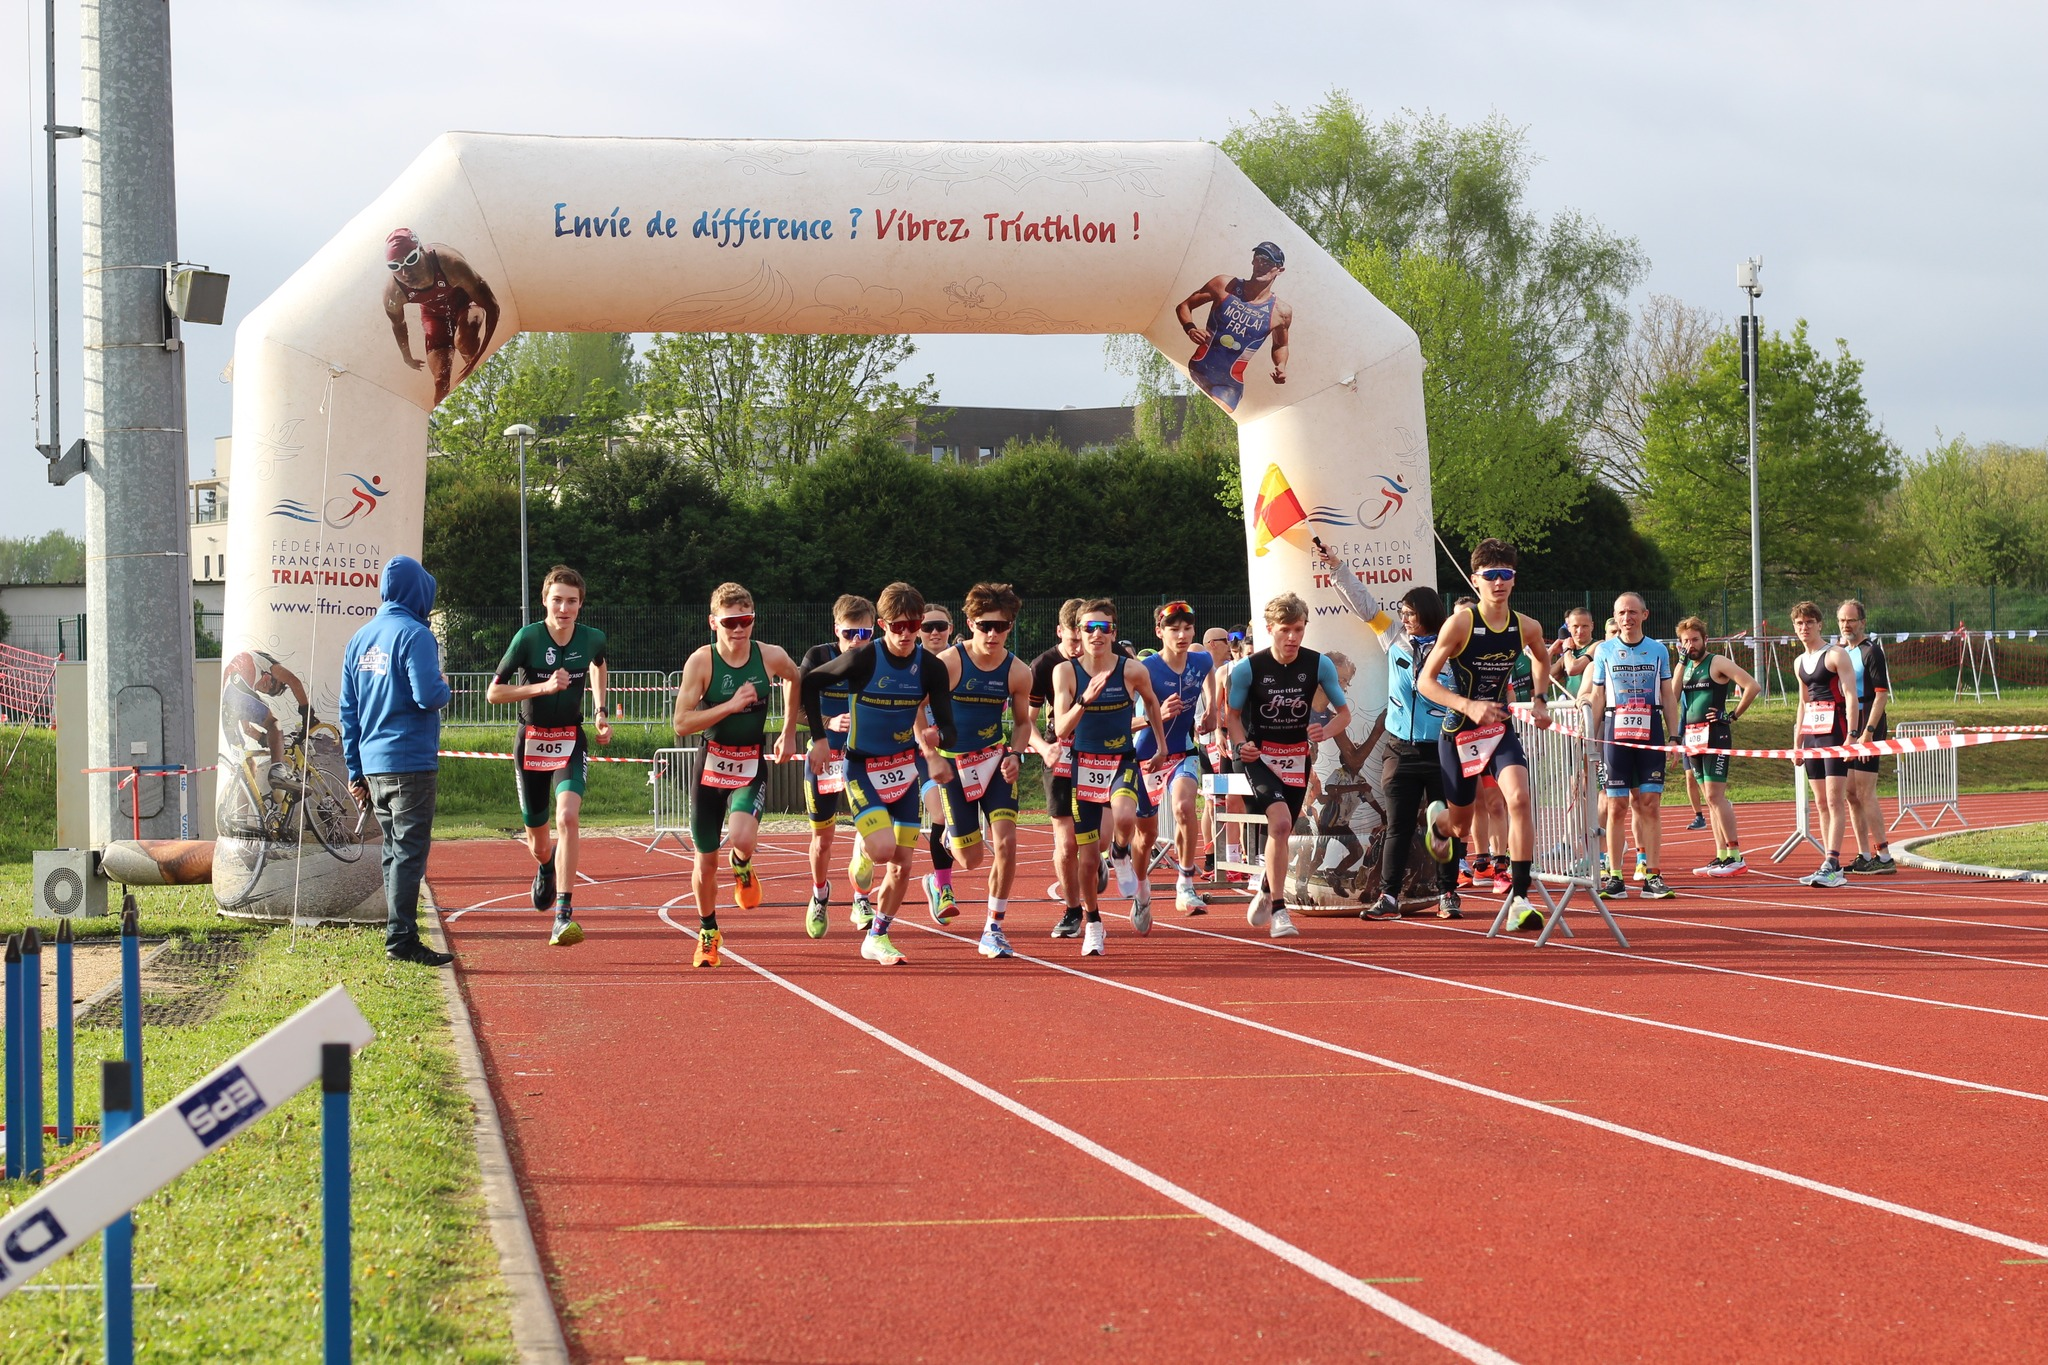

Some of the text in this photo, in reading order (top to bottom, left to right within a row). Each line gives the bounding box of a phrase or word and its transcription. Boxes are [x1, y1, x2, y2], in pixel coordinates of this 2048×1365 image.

[554, 203, 1140, 249] Envie de différence ? Vibrez Triathlon !
[1226, 320, 1246, 338] FRA
[272, 539, 380, 555] FÉDÉRATION
[1311, 540, 1410, 556] FDÉRATION
[272, 555, 379, 570] FRANÇAISE DE
[1312, 554, 1411, 570] FRÇAISE DE
[272, 570, 379, 588] TRIATHLON
[1313, 568, 1412, 588] TRTHLON
[1623, 716, 1642, 726] 378
[1473, 726, 1504, 737] balance
[536, 744, 562, 754] 405
[726, 750, 757, 758] balance
[974, 748, 1003, 762] balance
[1470, 744, 1478, 756] 3
[717, 761, 744, 772] 411
[868, 754, 913, 769] new balance
[1080, 757, 1094, 765] new
[828, 764, 844, 776] 39
[704, 775, 720, 783] new
[880, 770, 906, 785] 392
[1088, 772, 1112, 784] 391
[966, 788, 982, 798] new
[187, 1081, 256, 1134] EPS
